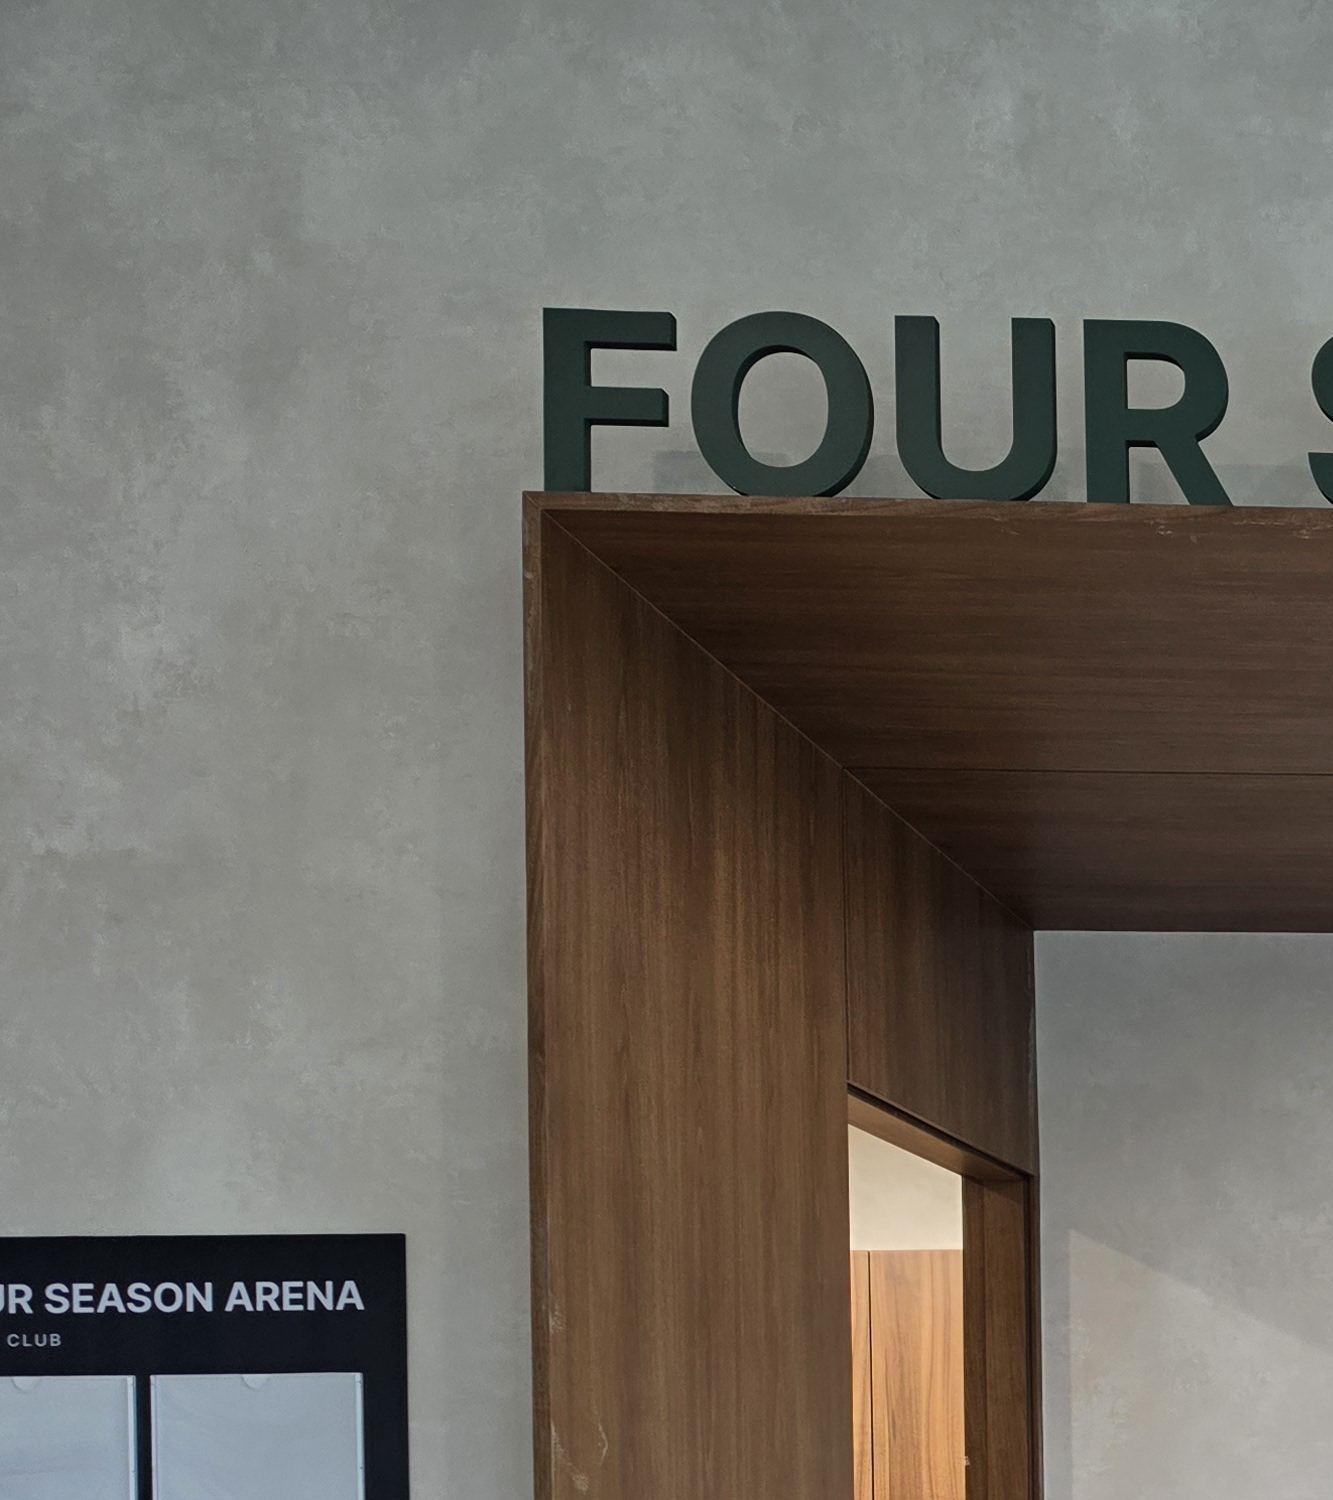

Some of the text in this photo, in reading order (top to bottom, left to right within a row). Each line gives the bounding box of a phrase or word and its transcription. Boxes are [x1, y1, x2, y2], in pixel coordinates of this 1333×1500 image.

[543, 306, 1234, 507] FOUR
[44, 1282, 213, 1314] SEASON
[224, 1280, 365, 1312] ARENA
[7, 1333, 62, 1347] CLUB
